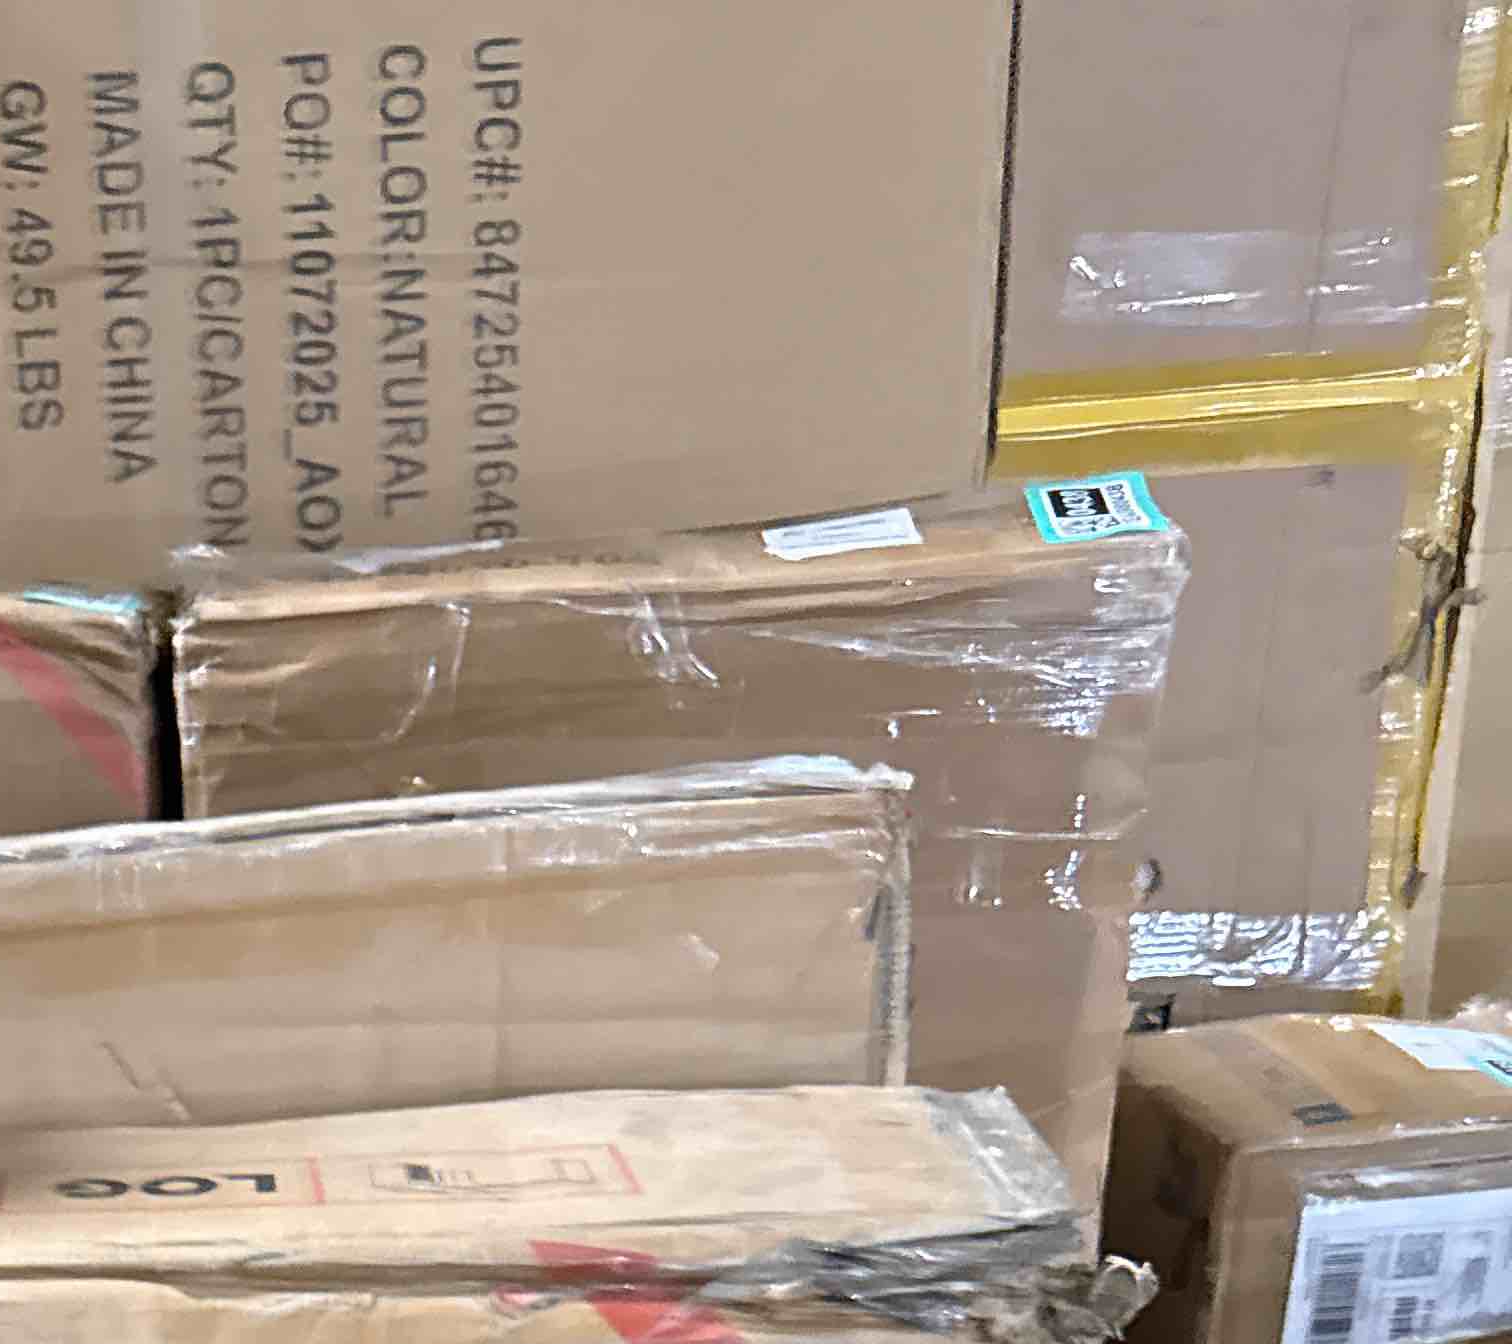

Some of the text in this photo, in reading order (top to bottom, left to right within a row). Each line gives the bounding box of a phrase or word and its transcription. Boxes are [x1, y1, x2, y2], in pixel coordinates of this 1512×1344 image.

[184, 61, 239, 189] QTY:
[281, 54, 333, 183] PO#:
[471, 37, 523, 205] UPC#:
[4, 208, 57, 307] 49.5
[88, 71, 158, 482] MADE IN CHINA
[12, 331, 64, 431] LBS
